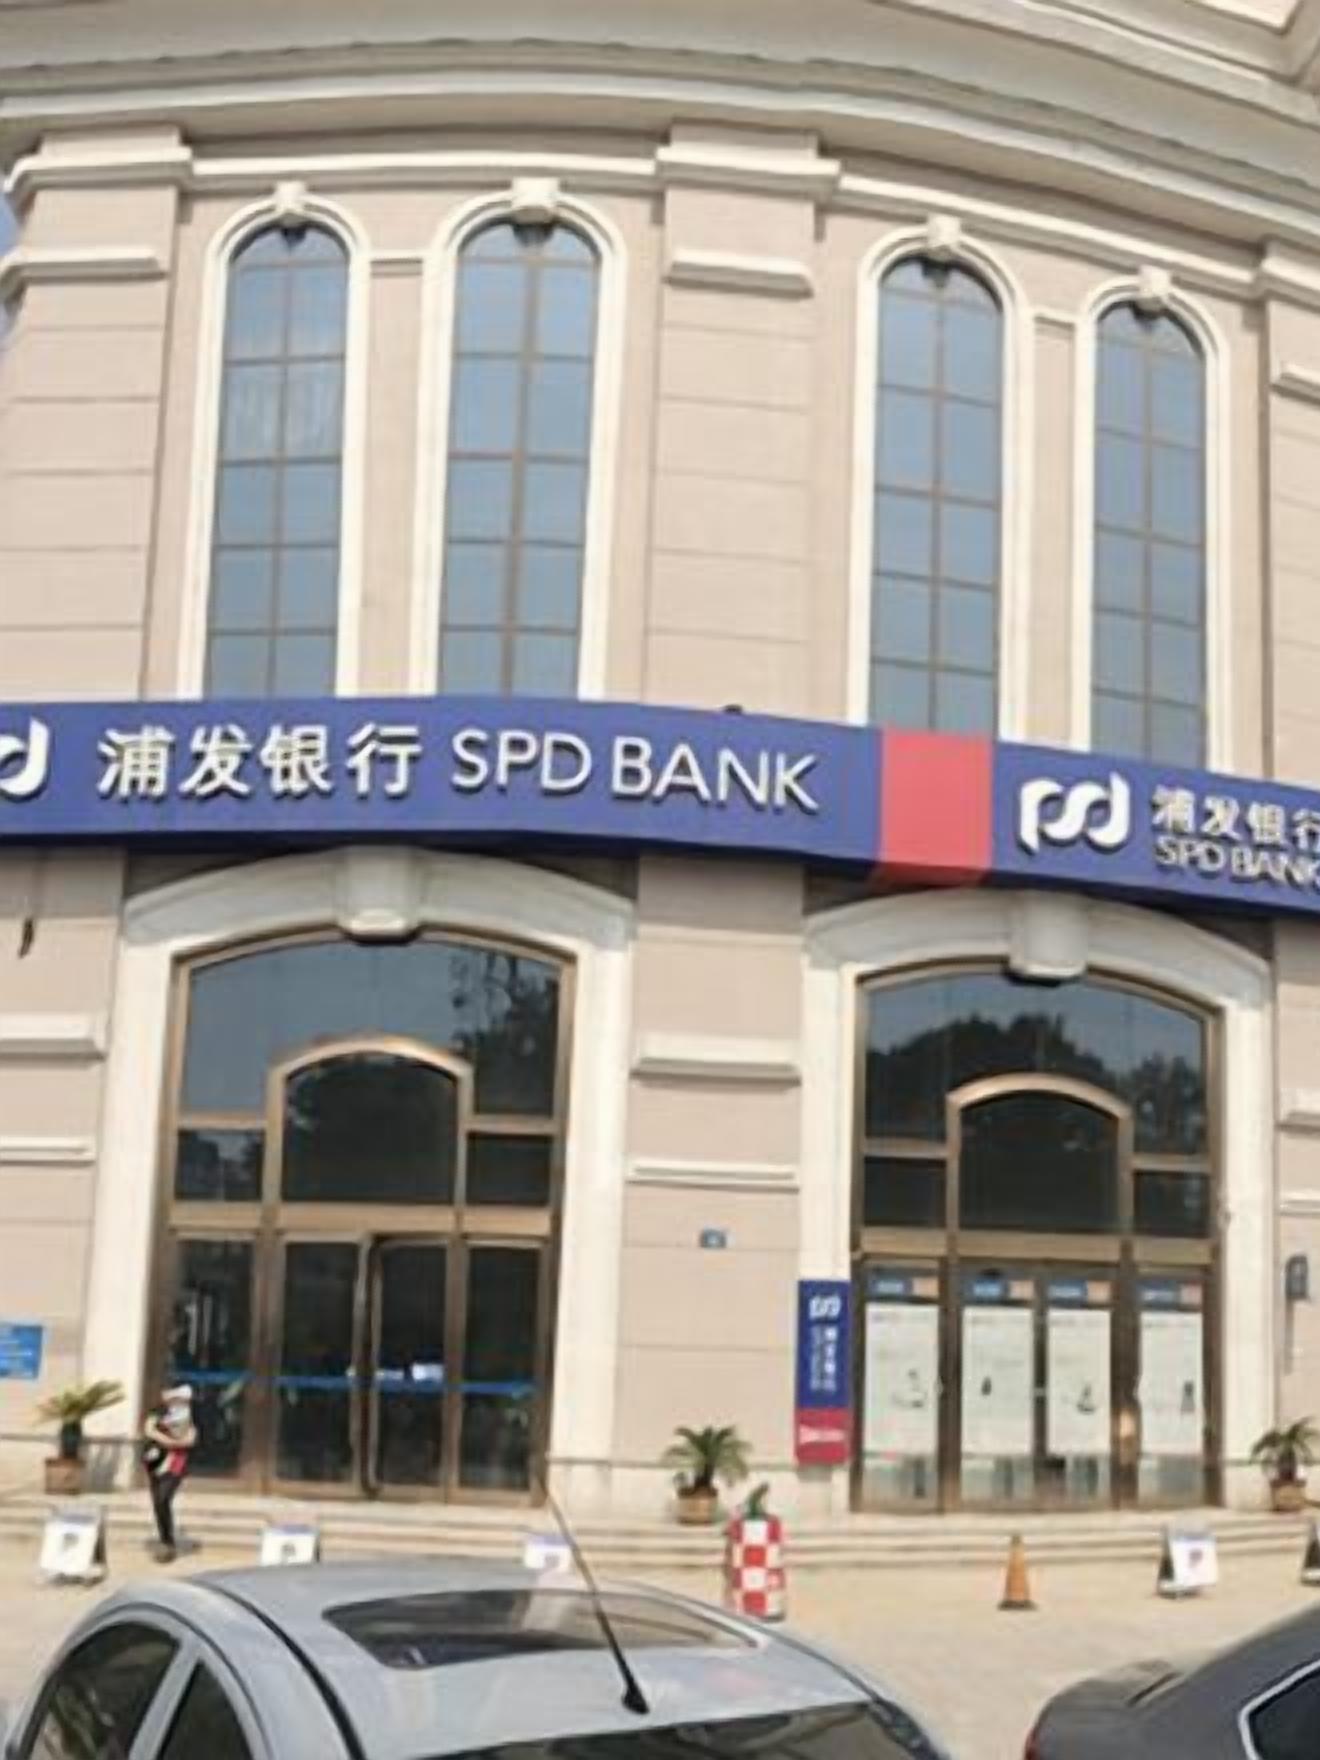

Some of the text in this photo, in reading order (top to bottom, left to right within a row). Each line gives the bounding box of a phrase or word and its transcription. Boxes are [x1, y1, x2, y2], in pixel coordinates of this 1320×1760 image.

[95, 723, 422, 798] 浦发银行
[451, 729, 820, 812] SPD BANK
